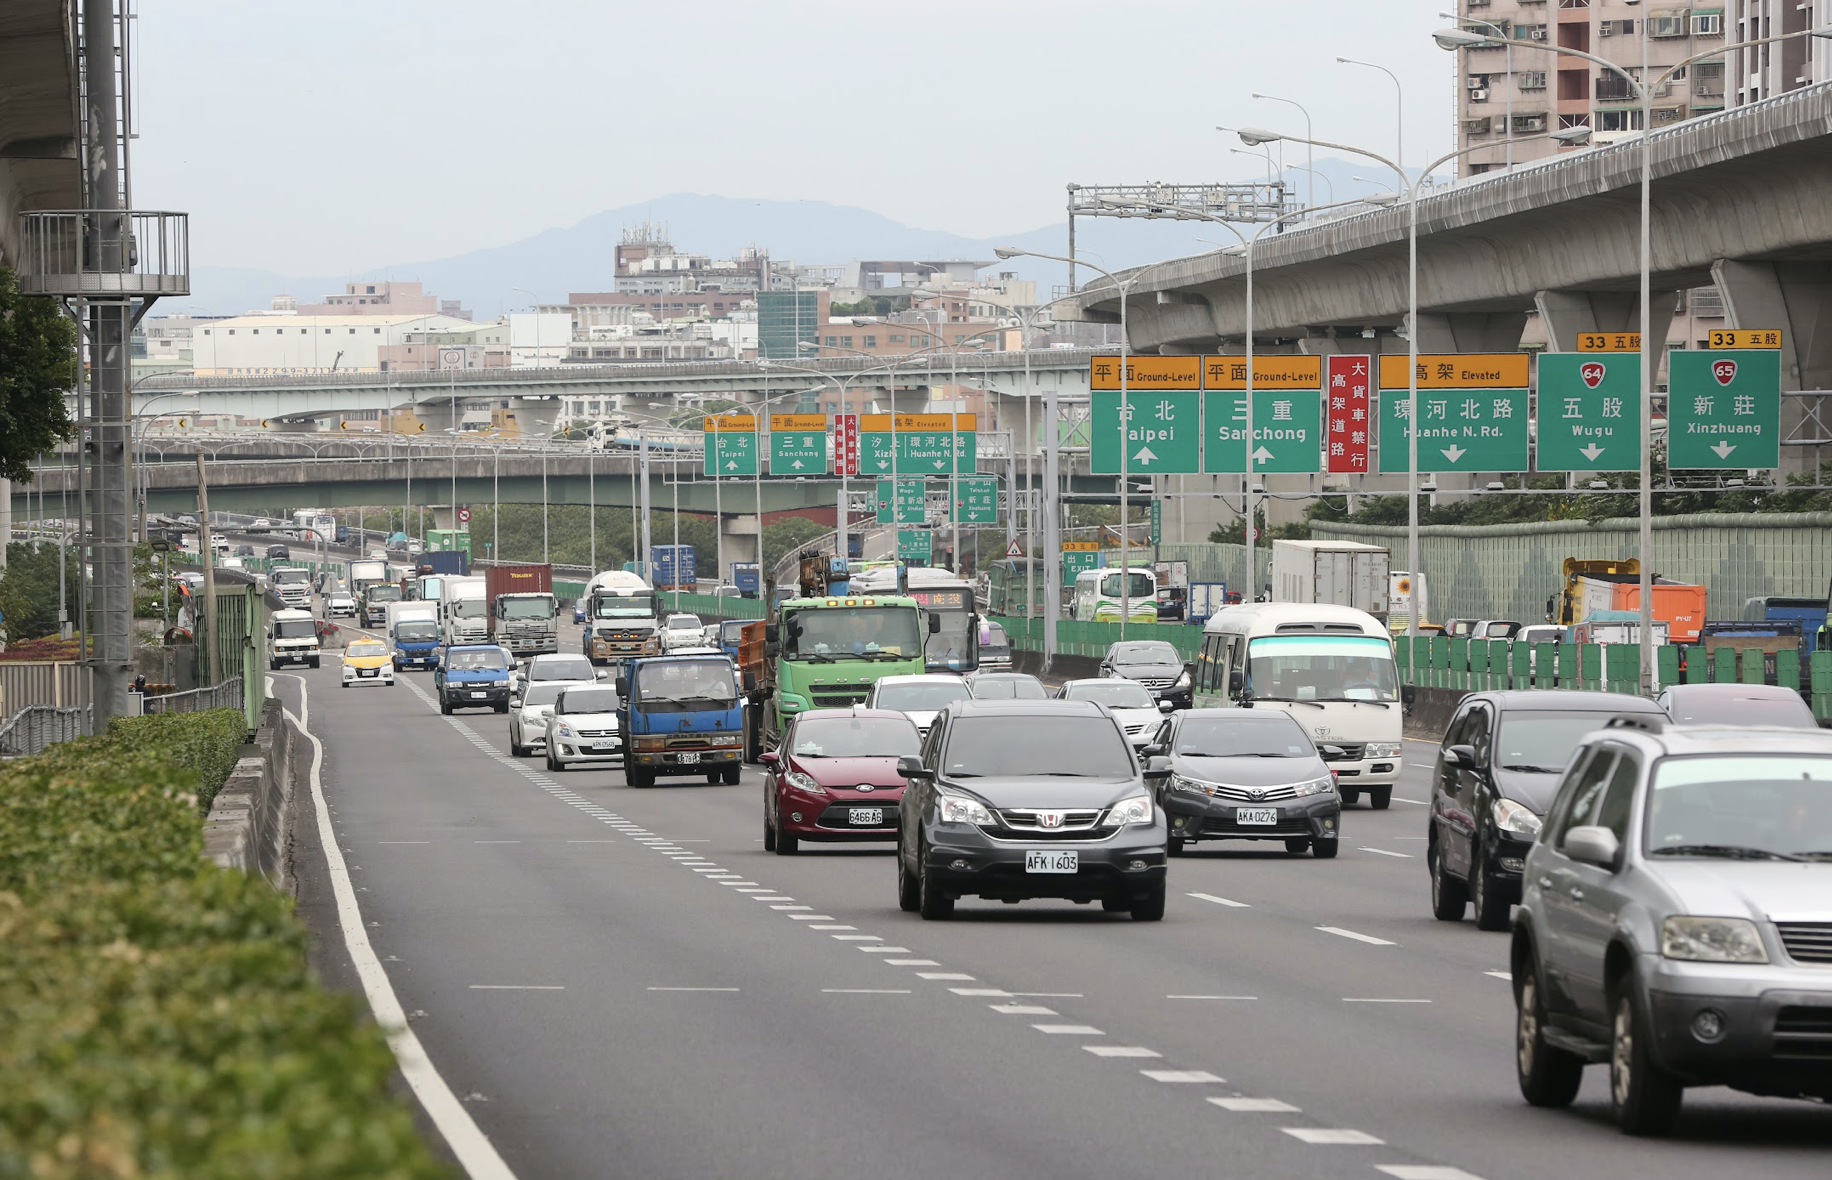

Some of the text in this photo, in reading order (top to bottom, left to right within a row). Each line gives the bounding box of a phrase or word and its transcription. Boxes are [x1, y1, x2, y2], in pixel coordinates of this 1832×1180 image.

[1585, 336, 1641, 348] 33 五股
[1713, 333, 1777, 345] 33 五股
[1095, 364, 1196, 382] 平面 Ground-Level
[1208, 364, 1318, 381] 平面 Ground-Level
[1416, 363, 1500, 380] 高架 Elevated
[1583, 367, 1601, 379] 64
[1715, 365, 1734, 377] 65
[1116, 400, 1175, 421] 台北
[1231, 399, 1293, 420] 三重
[1394, 398, 1513, 420] 環河北路
[1561, 397, 1623, 419] 五股
[1693, 394, 1755, 416] 新莊
[1331, 373, 1346, 457] 高架道路
[1351, 362, 1366, 467] 大貨車禁行
[772, 417, 794, 427] 平面
[1462, 426, 1477, 437] N.
[1481, 426, 1503, 437] Rd.
[1571, 425, 1613, 438] Wugu
[1687, 422, 1762, 436] Xinzhuang
[716, 436, 748, 449] 台北
[782, 436, 814, 448] 三重
[910, 436, 966, 448] 環河北路
[720, 450, 746, 458] Taipei
[778, 450, 819, 458] Sanchong
[910, 449, 942, 458] Huanhe
[1067, 554, 1094, 564] 出口
[1027, 856, 1077, 870] AFK-1603
